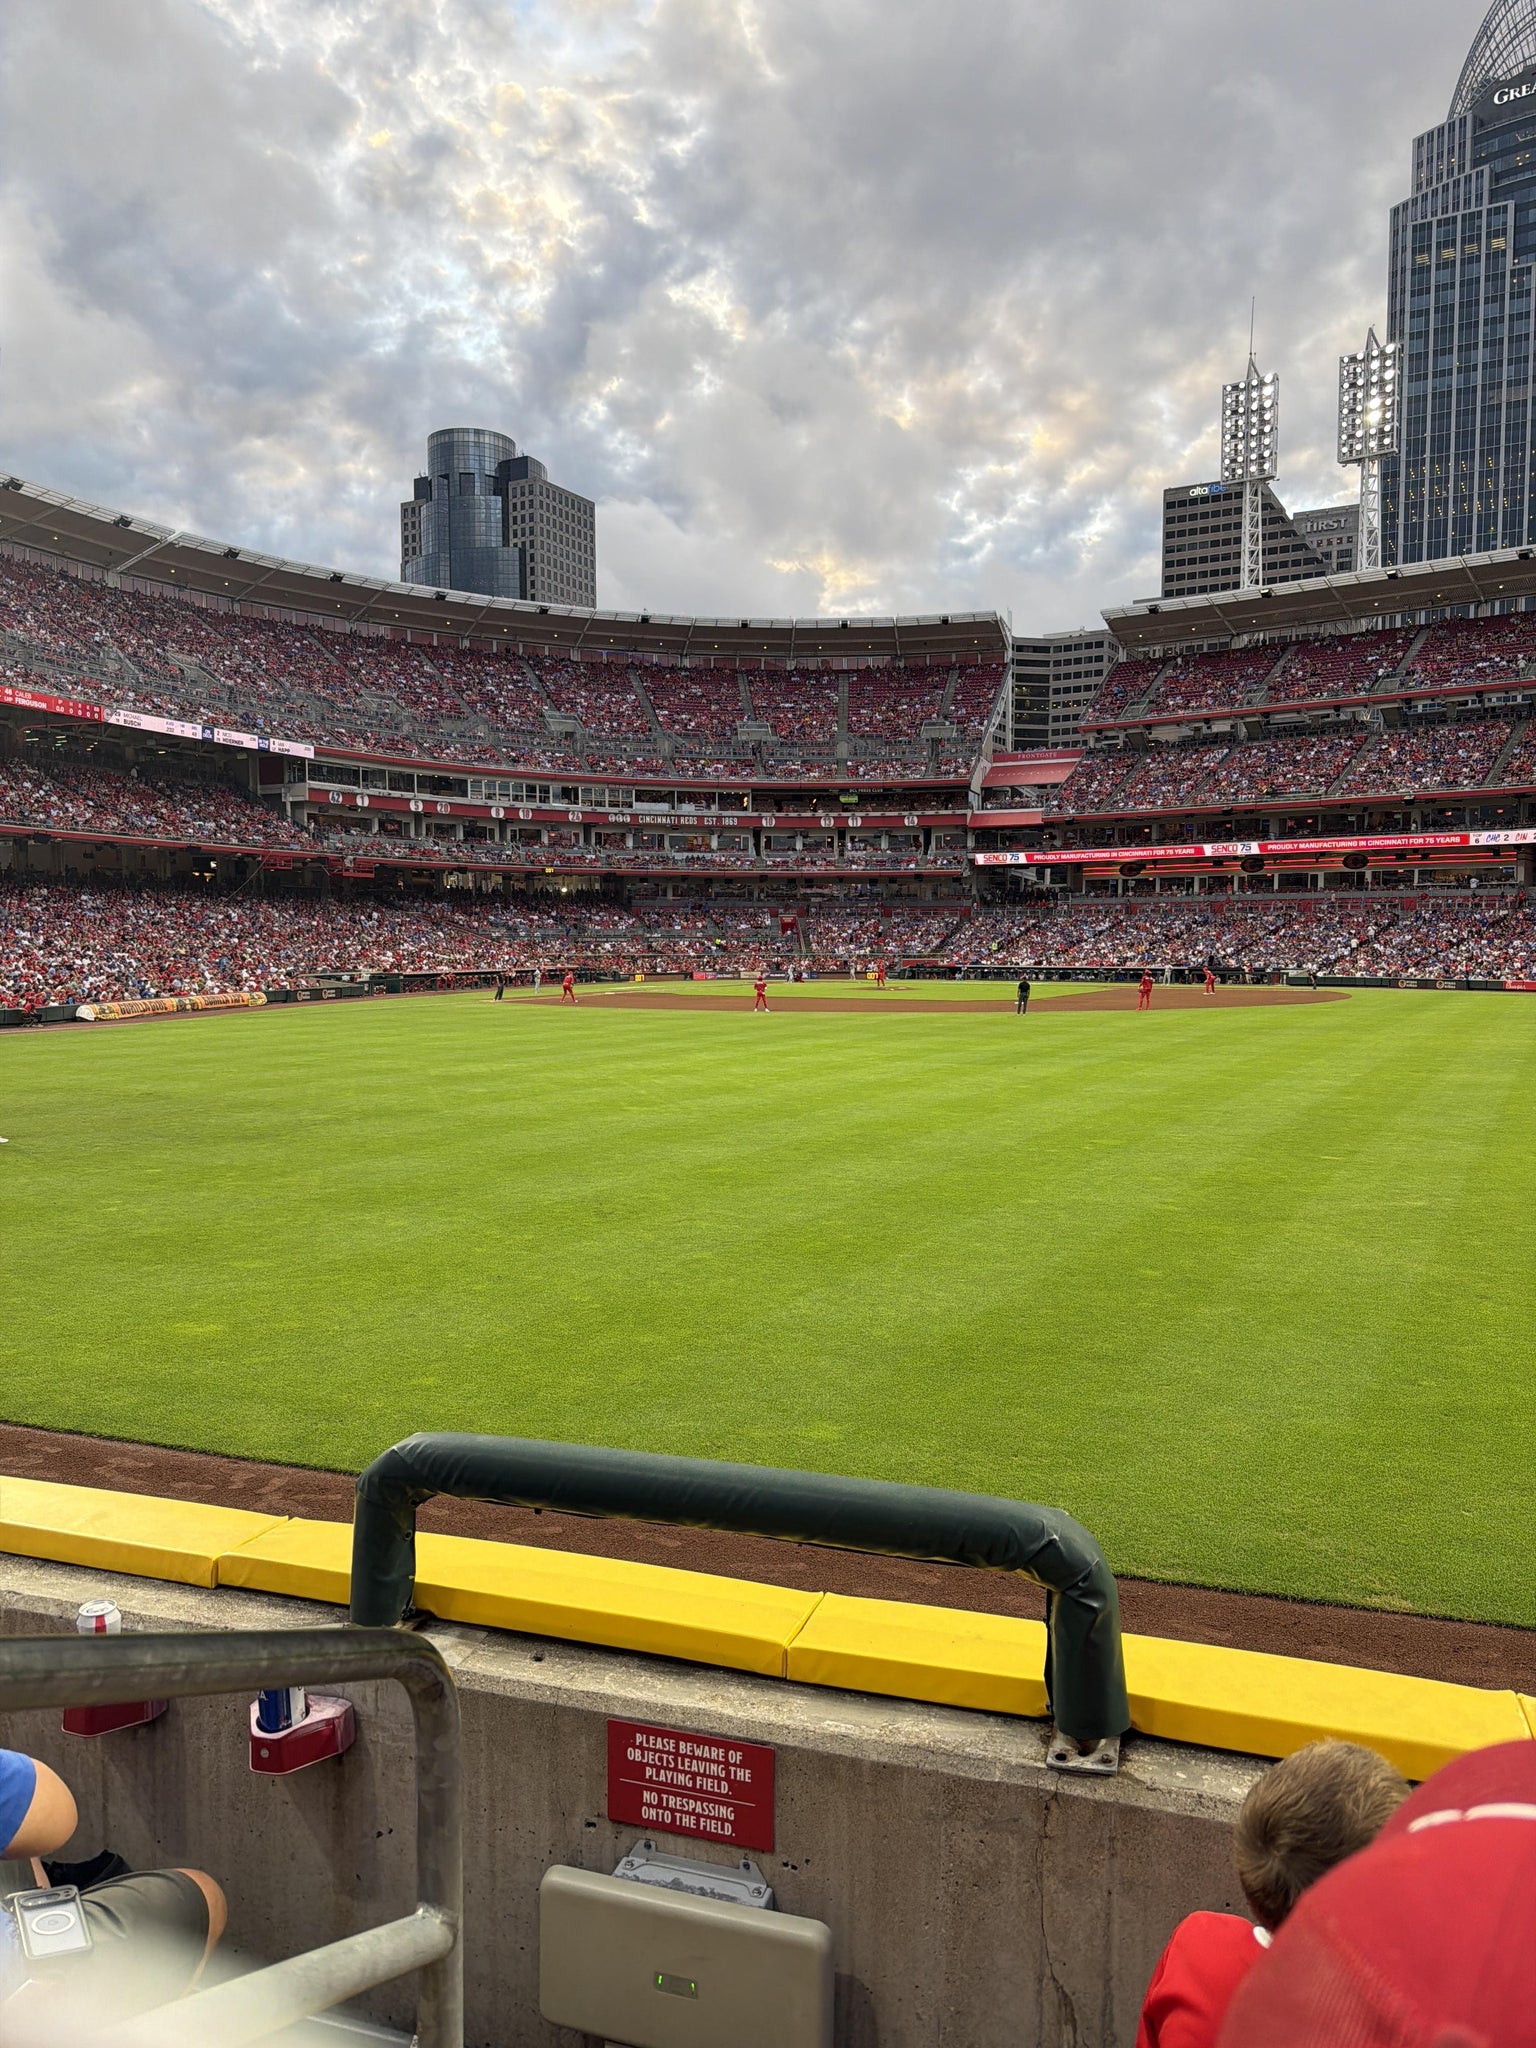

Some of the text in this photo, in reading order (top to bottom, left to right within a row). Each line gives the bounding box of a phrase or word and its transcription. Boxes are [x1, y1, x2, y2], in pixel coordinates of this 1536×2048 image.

[15, 697, 47, 709] FERGUSON
[123, 719, 142, 727] BUSCH
[638, 815, 678, 825] CINCINNATI
[680, 816, 698, 825] REDS
[704, 817, 720, 825] EST.
[722, 817, 738, 826] 1869
[1485, 833, 1501, 843] CHC
[1514, 832, 1528, 841] CIN
[1211, 843, 1252, 853] SENCO 75
[1298, 840, 1358, 849] MANUFACTURING
[1367, 838, 1408, 846] CINCINNATI
[983, 853, 1020, 862] SENCO 75
[1060, 852, 1110, 860] MANUFACTURING
[636, 1733, 743, 1764] PLEASE BEWARE OF
[627, 1748, 752, 1782] OBJECTS LEAVING THE
[645, 1767, 732, 1795] PLAYING FIELD.
[643, 1790, 735, 1820] NO TRESPASSING
[641, 1805, 736, 1837] ONTO THE FIELD.
